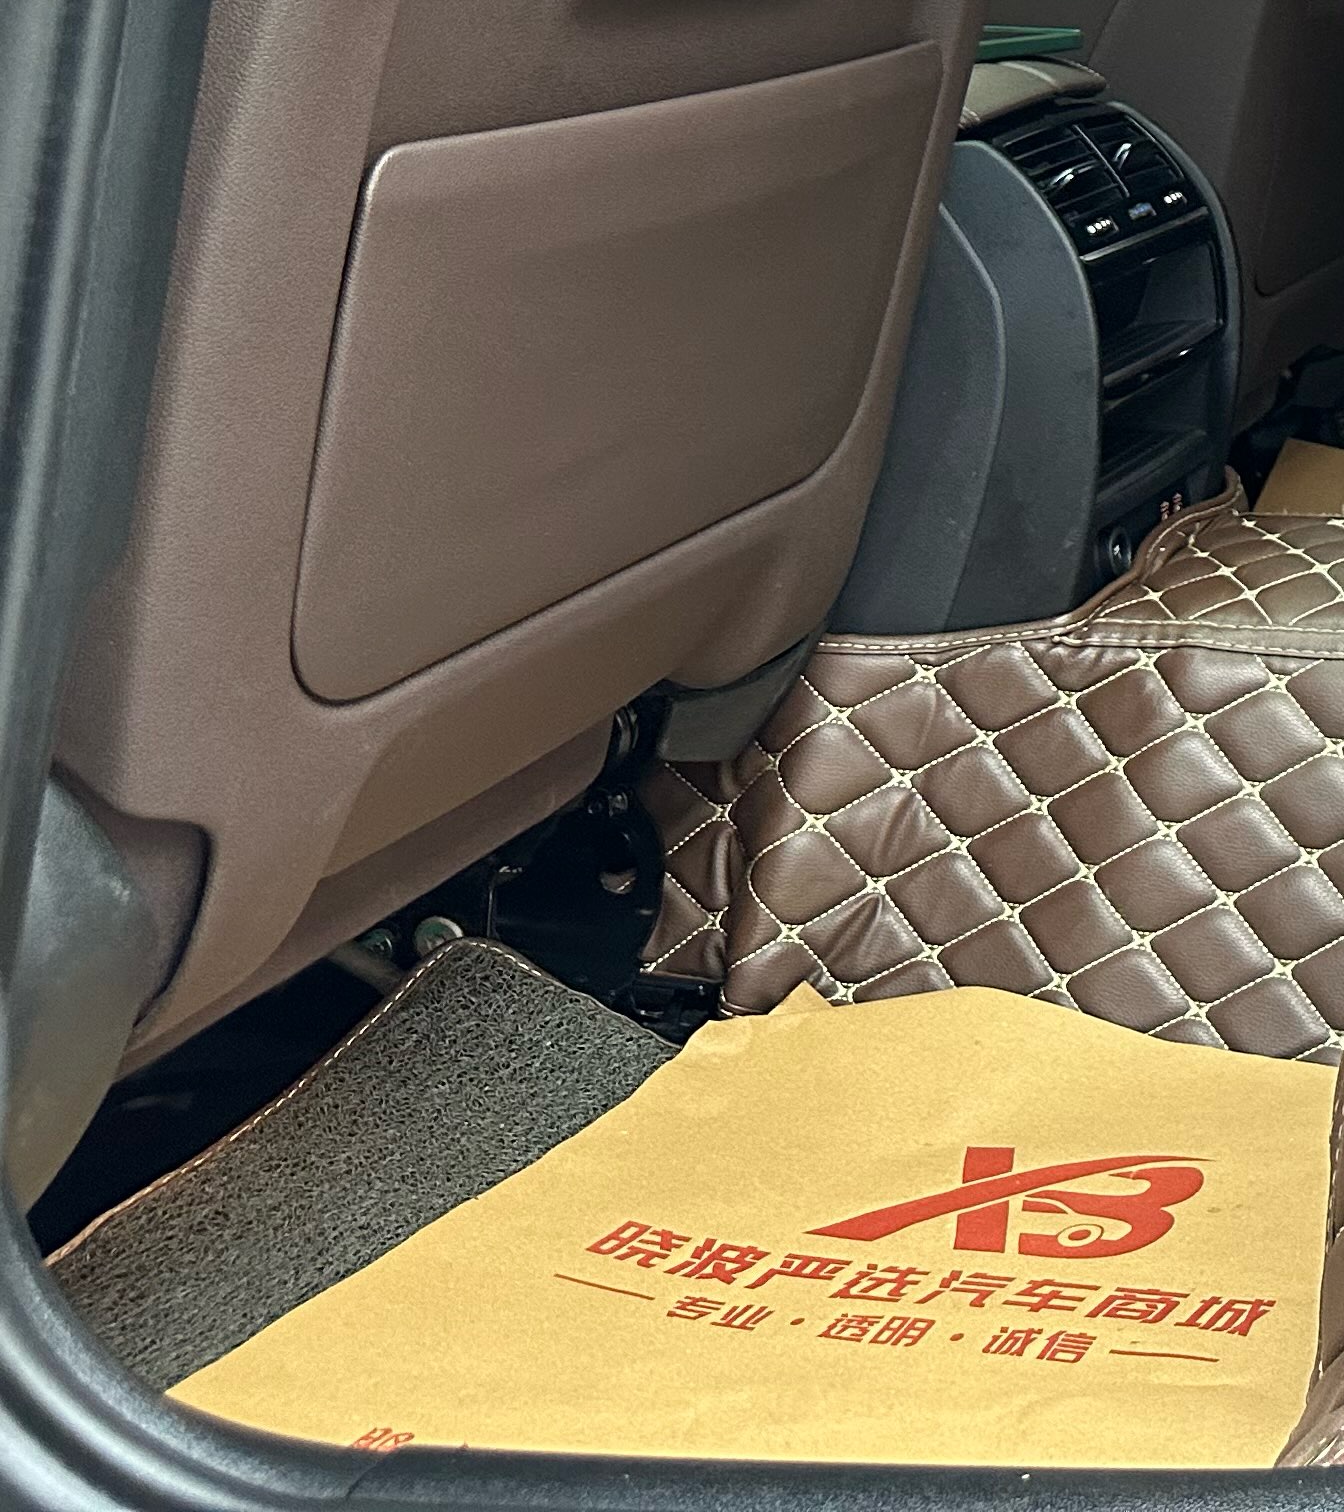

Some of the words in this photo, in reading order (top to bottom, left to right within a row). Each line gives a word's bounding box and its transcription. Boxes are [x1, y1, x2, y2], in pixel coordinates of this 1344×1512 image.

[585, 1219, 1277, 1337] 晓波严选汽车商城
